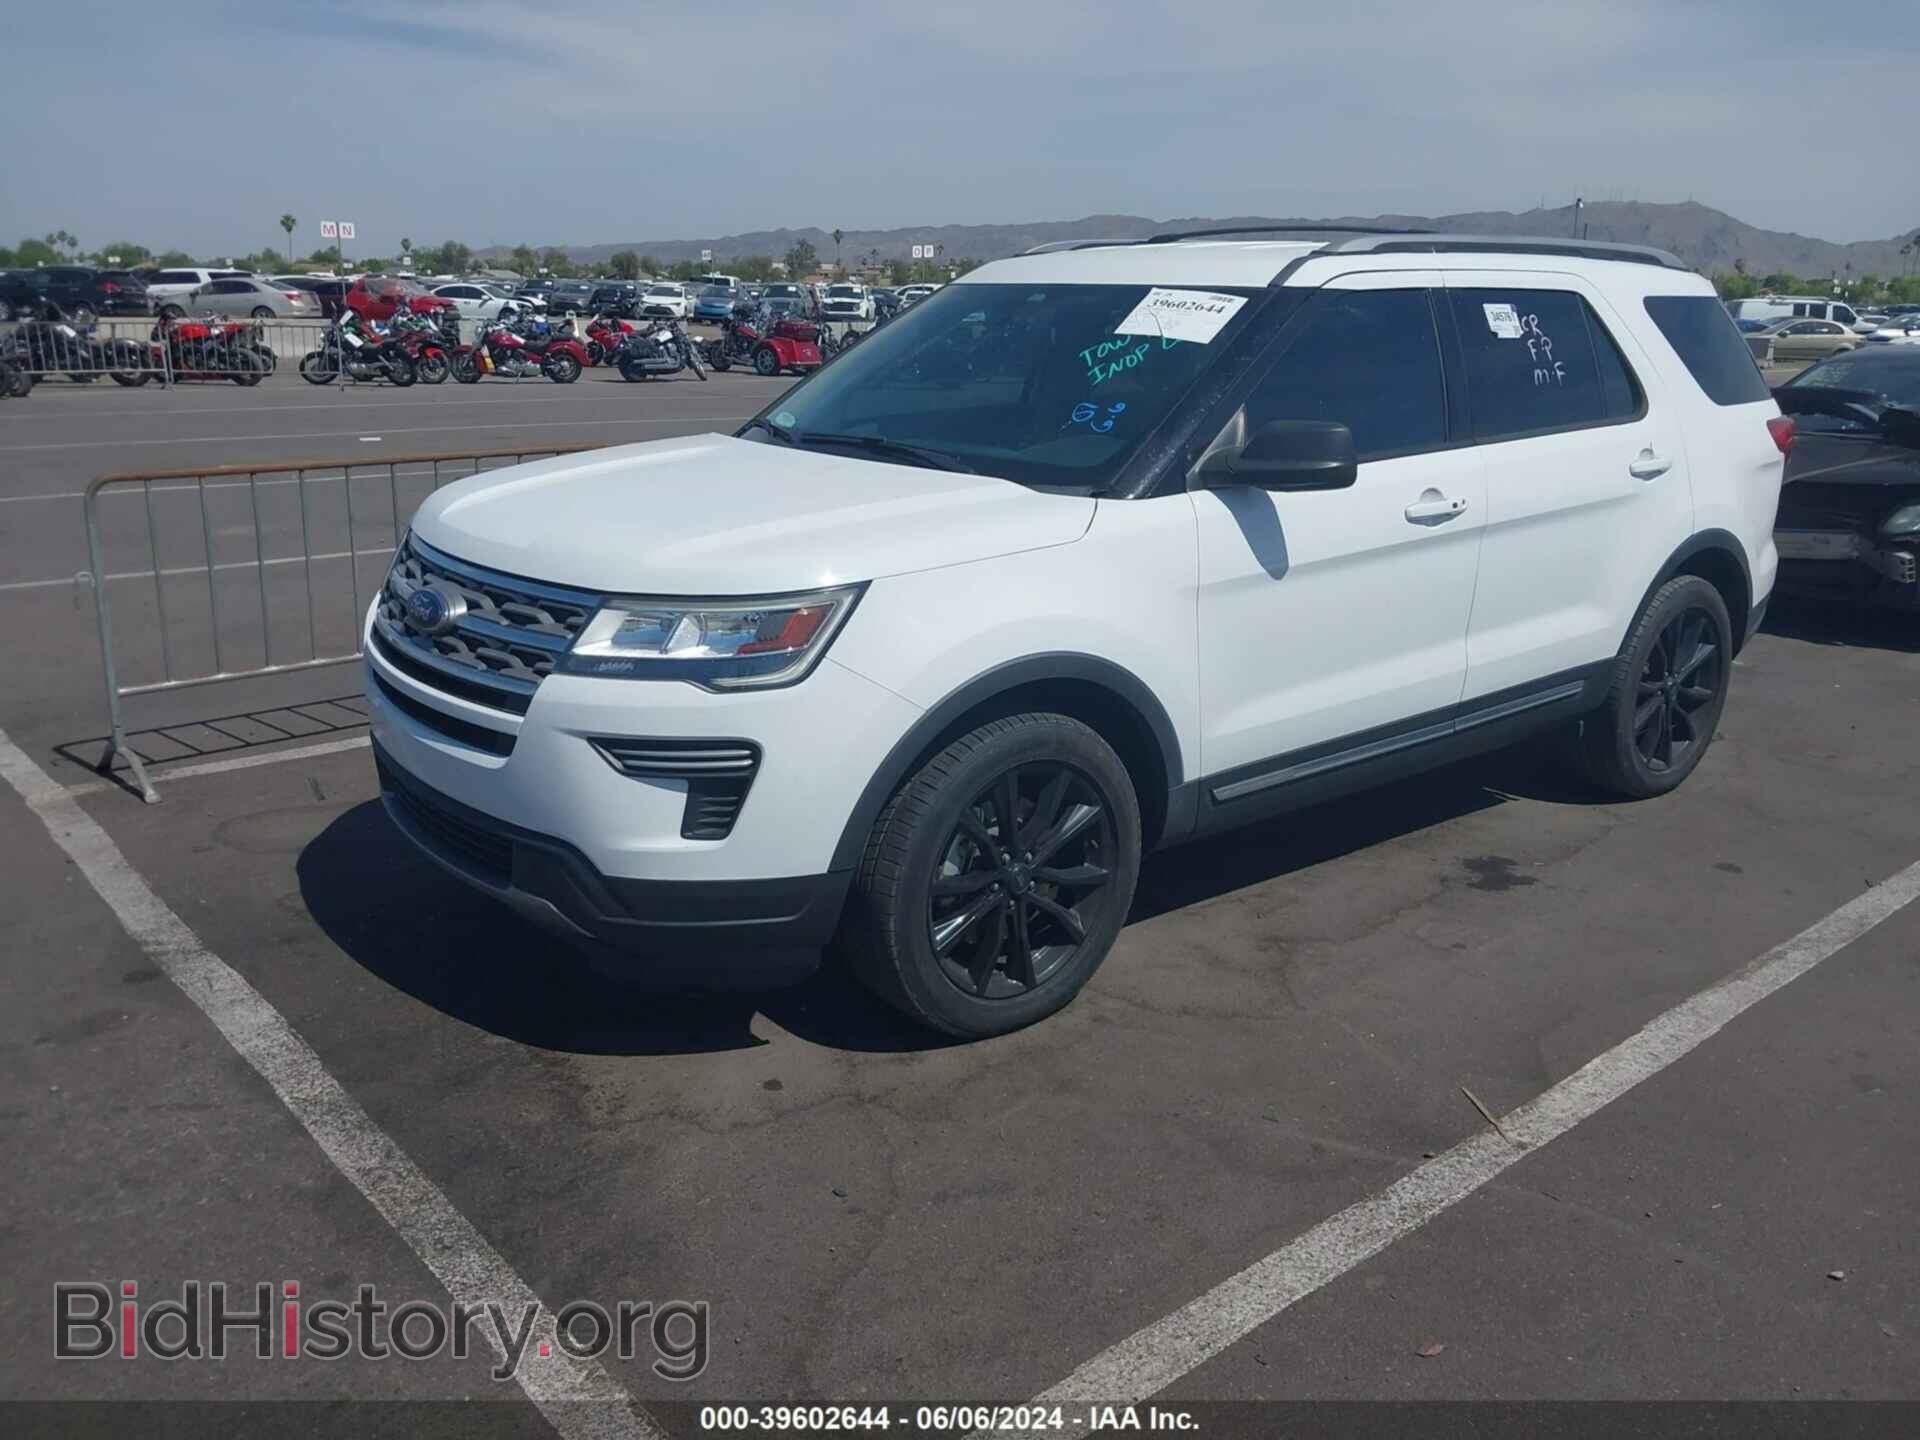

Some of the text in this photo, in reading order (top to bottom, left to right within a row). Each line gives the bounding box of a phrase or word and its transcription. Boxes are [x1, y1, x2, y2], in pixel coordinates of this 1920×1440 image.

[323, 224, 335, 235] M
[342, 225, 352, 236] N
[1087, 343, 1149, 386] INOP
